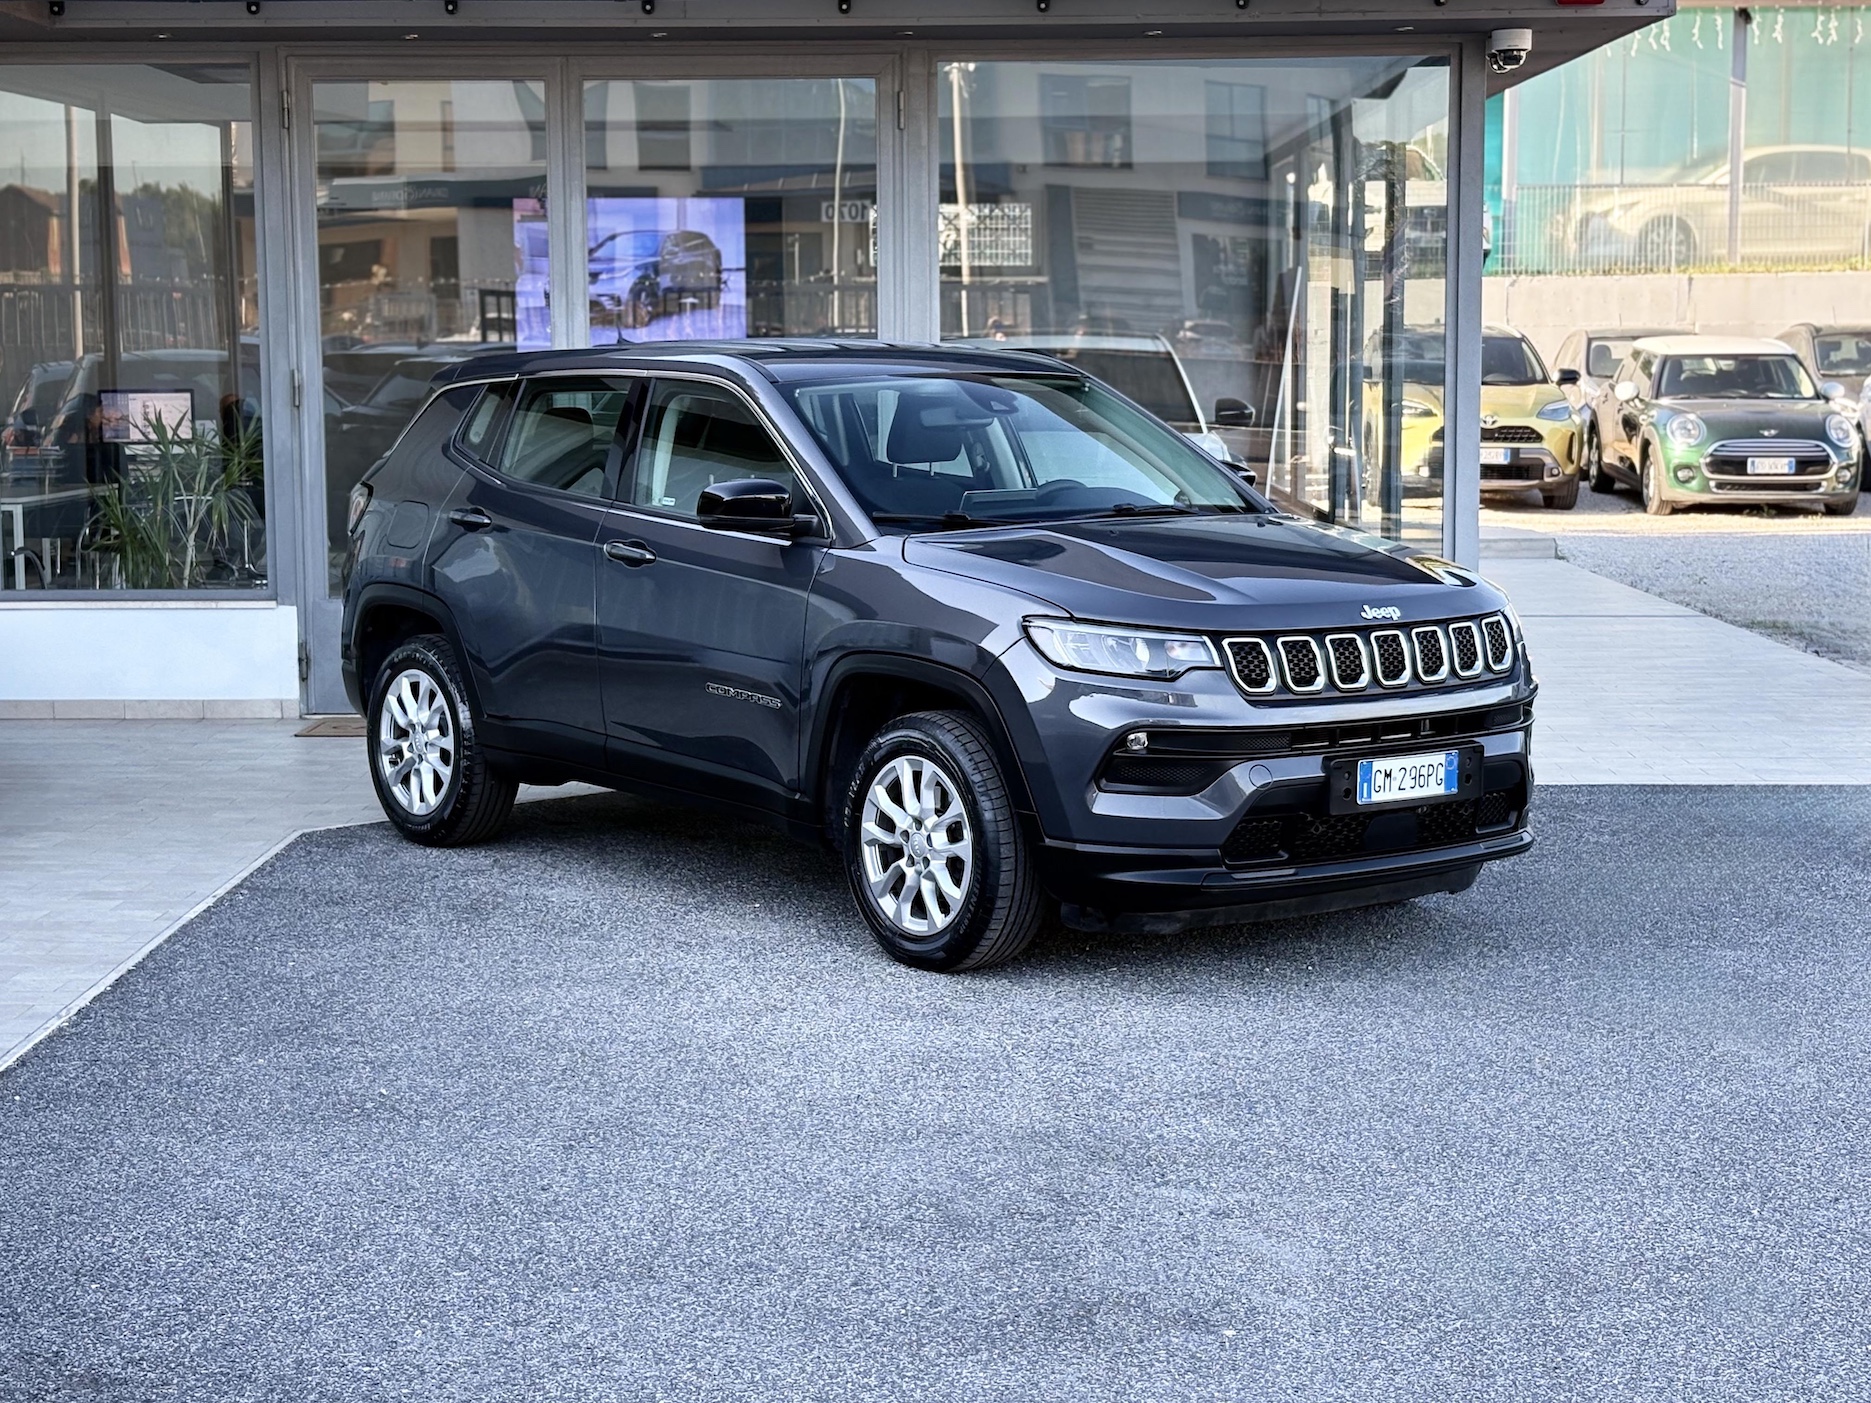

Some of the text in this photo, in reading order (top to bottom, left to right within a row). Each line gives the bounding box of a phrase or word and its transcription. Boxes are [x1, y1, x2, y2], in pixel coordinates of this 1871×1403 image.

[1360, 604, 1401, 621] Jeep
[705, 682, 782, 709] COMPASS
[1373, 762, 1444, 793] GM 296PG
